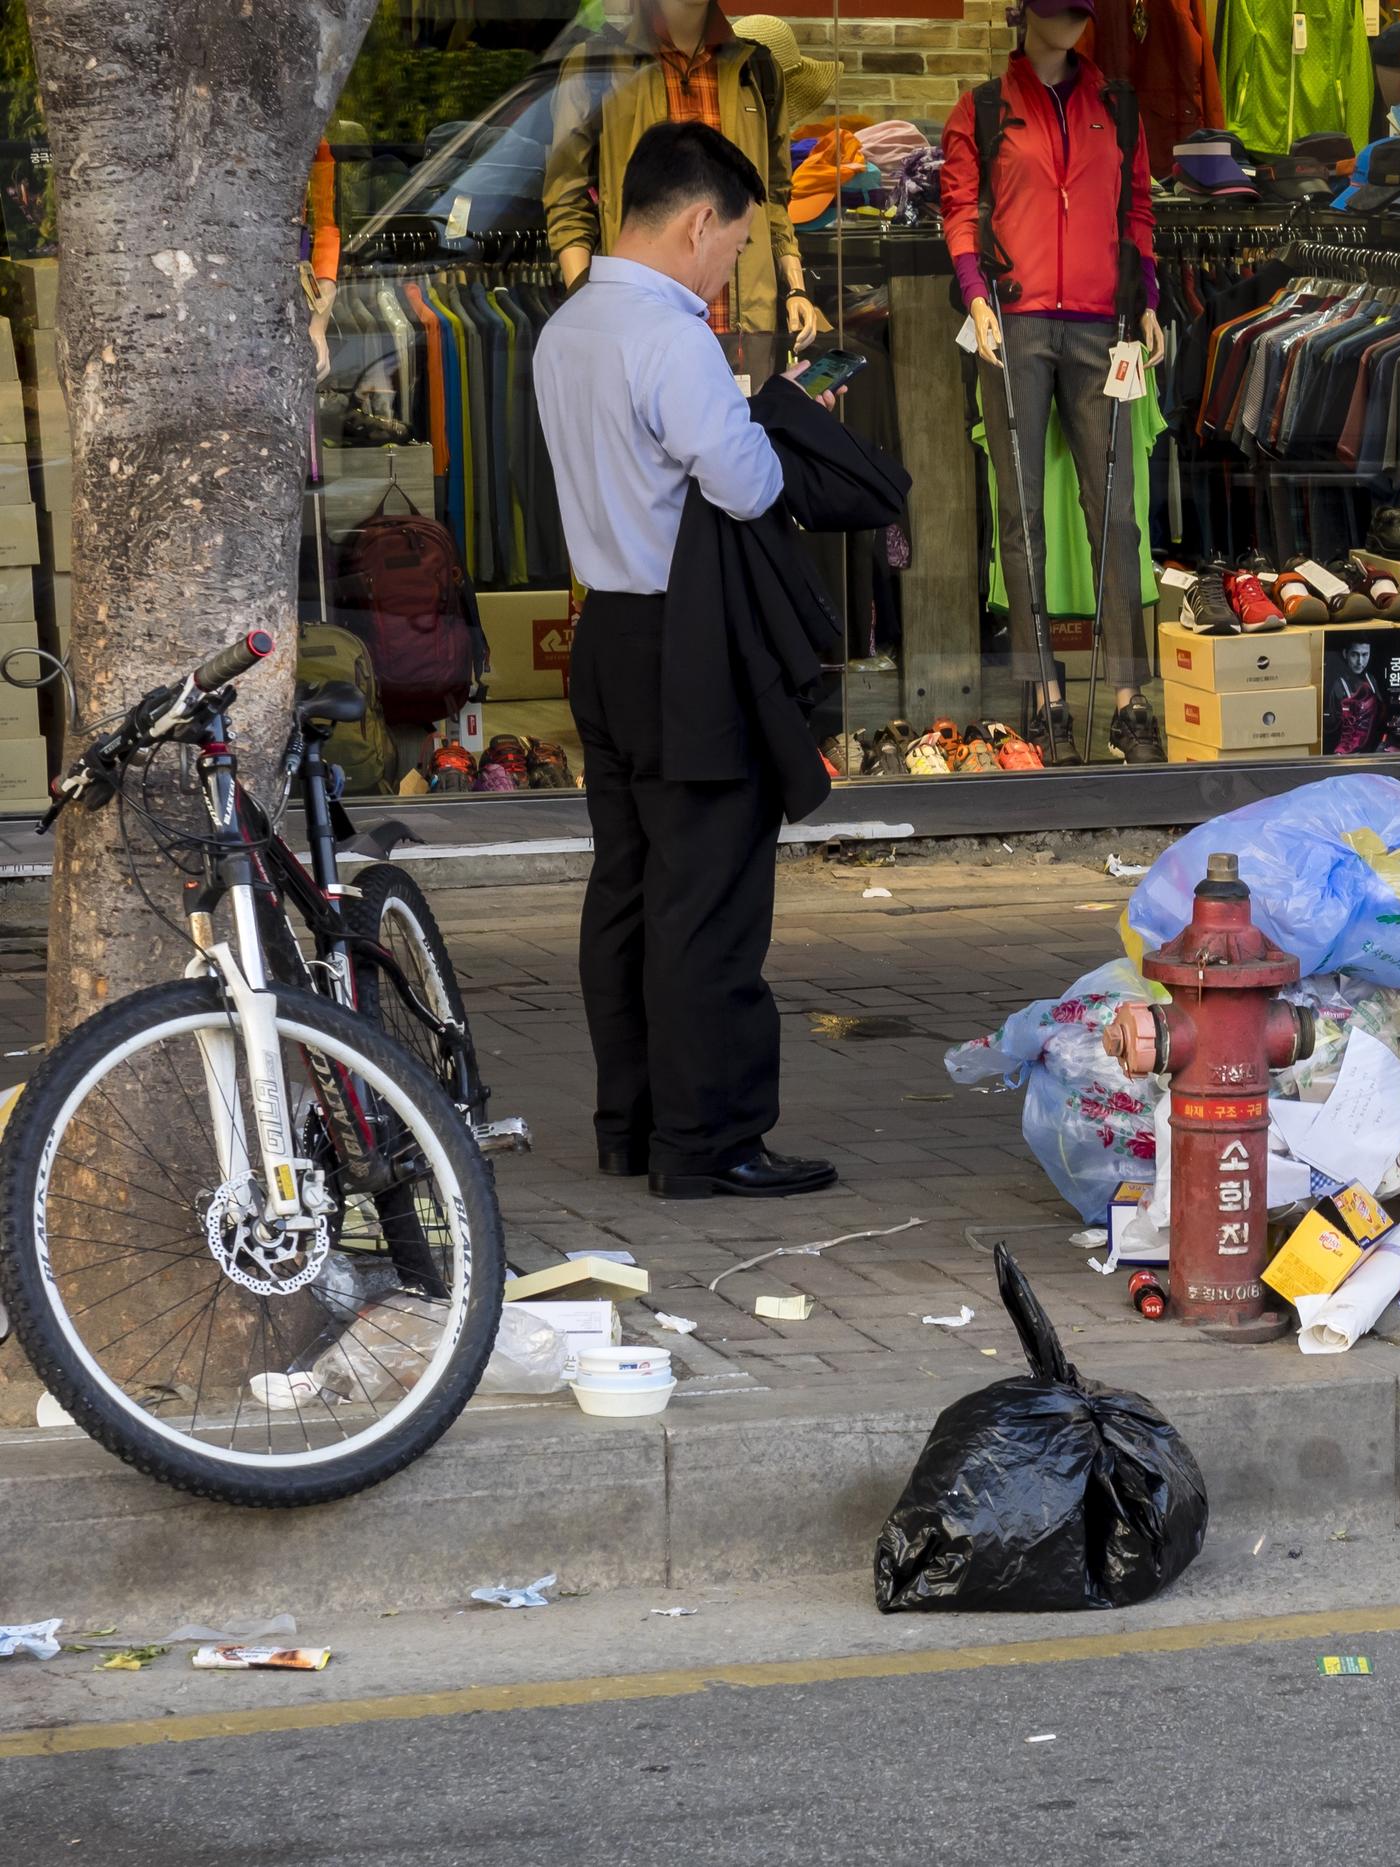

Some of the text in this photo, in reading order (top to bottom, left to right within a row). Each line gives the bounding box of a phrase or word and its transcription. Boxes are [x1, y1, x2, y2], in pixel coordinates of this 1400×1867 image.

[1184, 1103, 1263, 1118] 화재 구조 구급
[1217, 1139, 1252, 1256] 소화전
